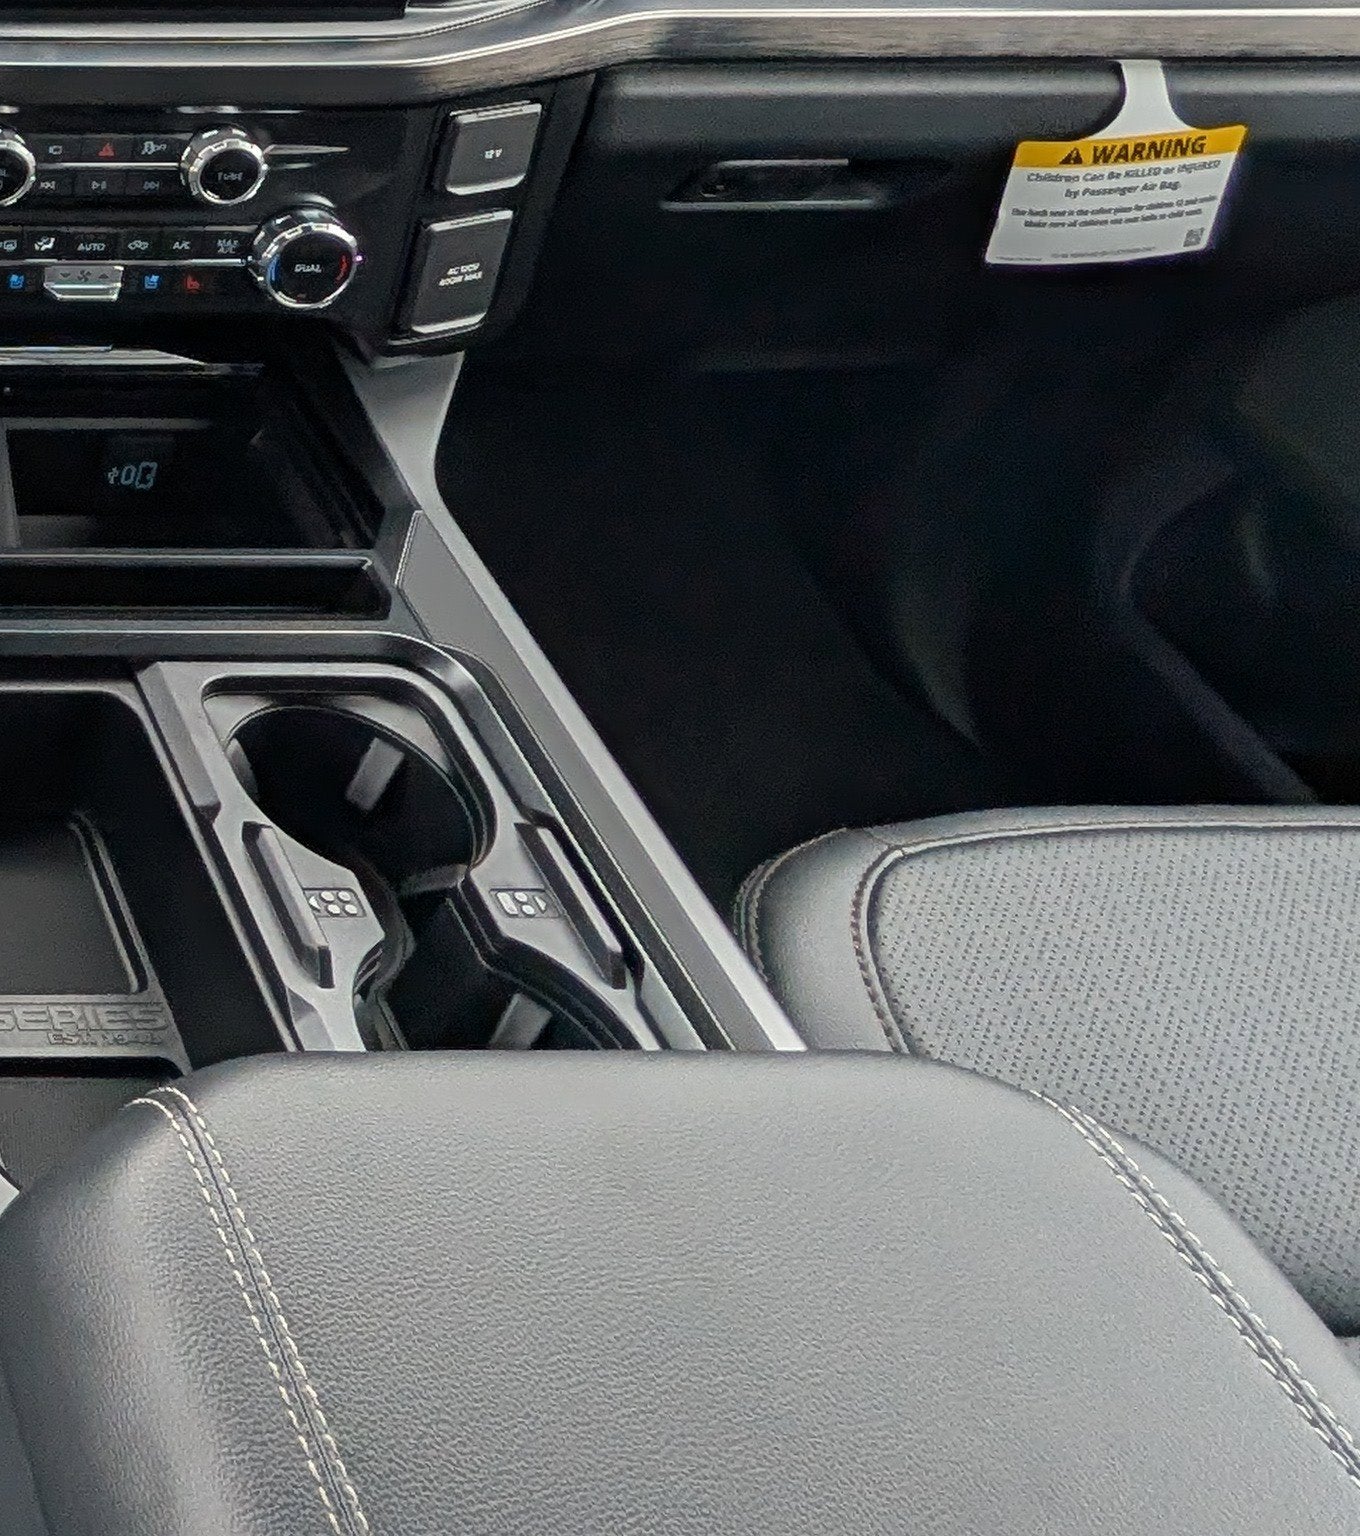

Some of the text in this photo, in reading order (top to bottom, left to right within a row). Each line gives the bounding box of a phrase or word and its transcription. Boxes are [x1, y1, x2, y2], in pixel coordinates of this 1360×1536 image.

[1092, 135, 1208, 164] WARNING
[1026, 170, 1080, 183] Children
[1082, 171, 1105, 183] Can
[1107, 170, 1121, 180] Be
[1123, 166, 1162, 179] KILLED
[1162, 166, 1175, 175] or
[1064, 187, 1080, 199] by
[1081, 184, 1140, 197] Passenger
[1140, 182, 1158, 192] Air
[77, 242, 107, 252] AUTO
[172, 240, 191, 251] A/C
[294, 264, 323, 274] DUAL
